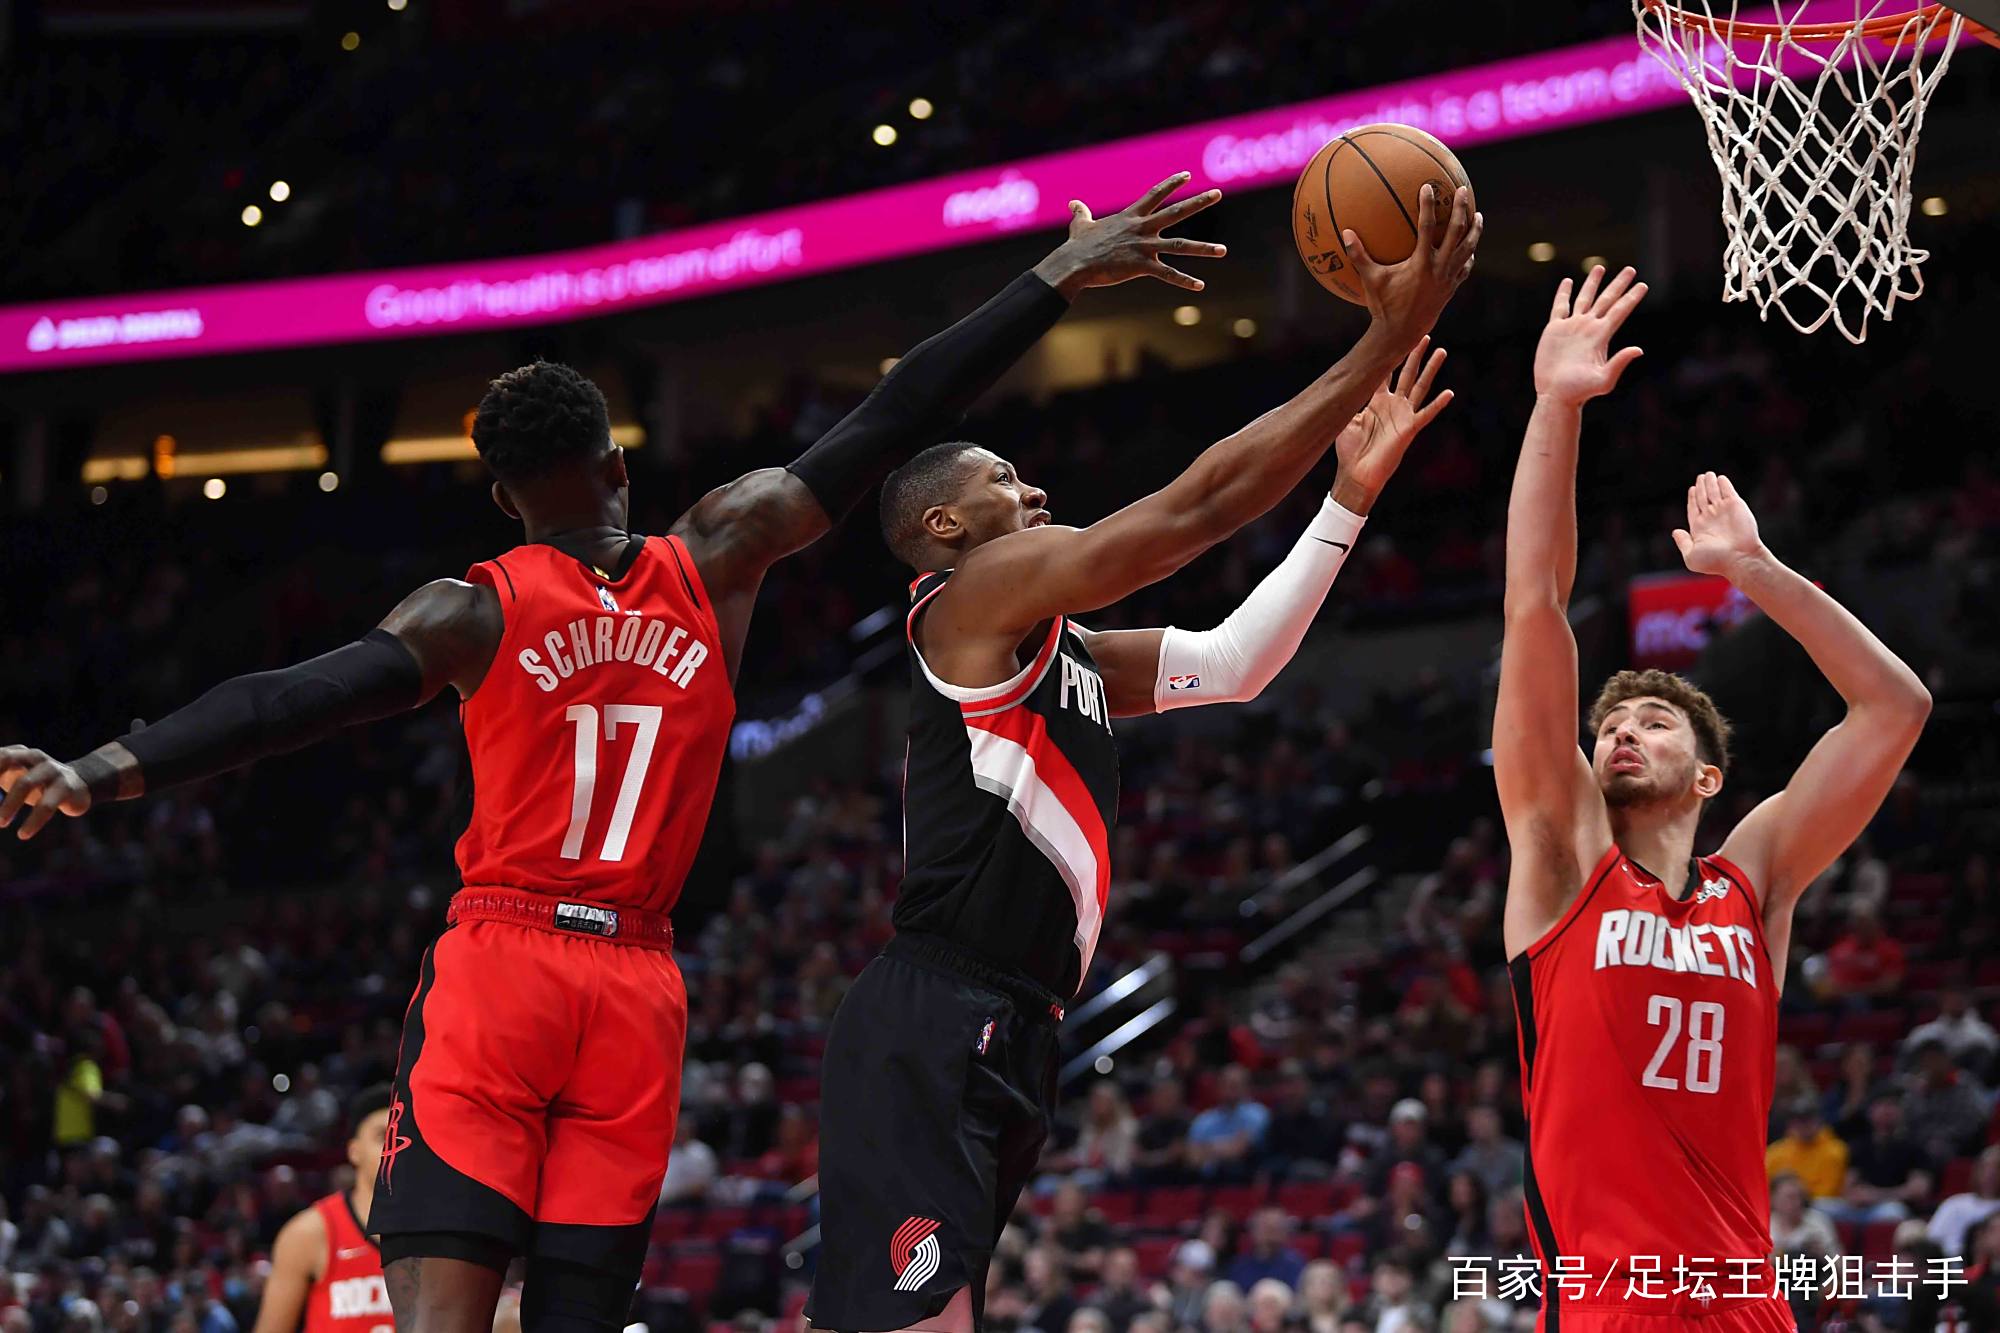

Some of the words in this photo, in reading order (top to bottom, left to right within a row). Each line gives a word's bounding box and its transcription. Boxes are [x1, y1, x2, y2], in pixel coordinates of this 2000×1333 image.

[1203, 118, 1304, 182] Good
[1501, 67, 1611, 125] team
[518, 609, 709, 692] SCHRÖDER
[560, 703, 663, 862] 17
[1594, 908, 1757, 989] ROCKETS
[1641, 994, 1725, 1094] 28
